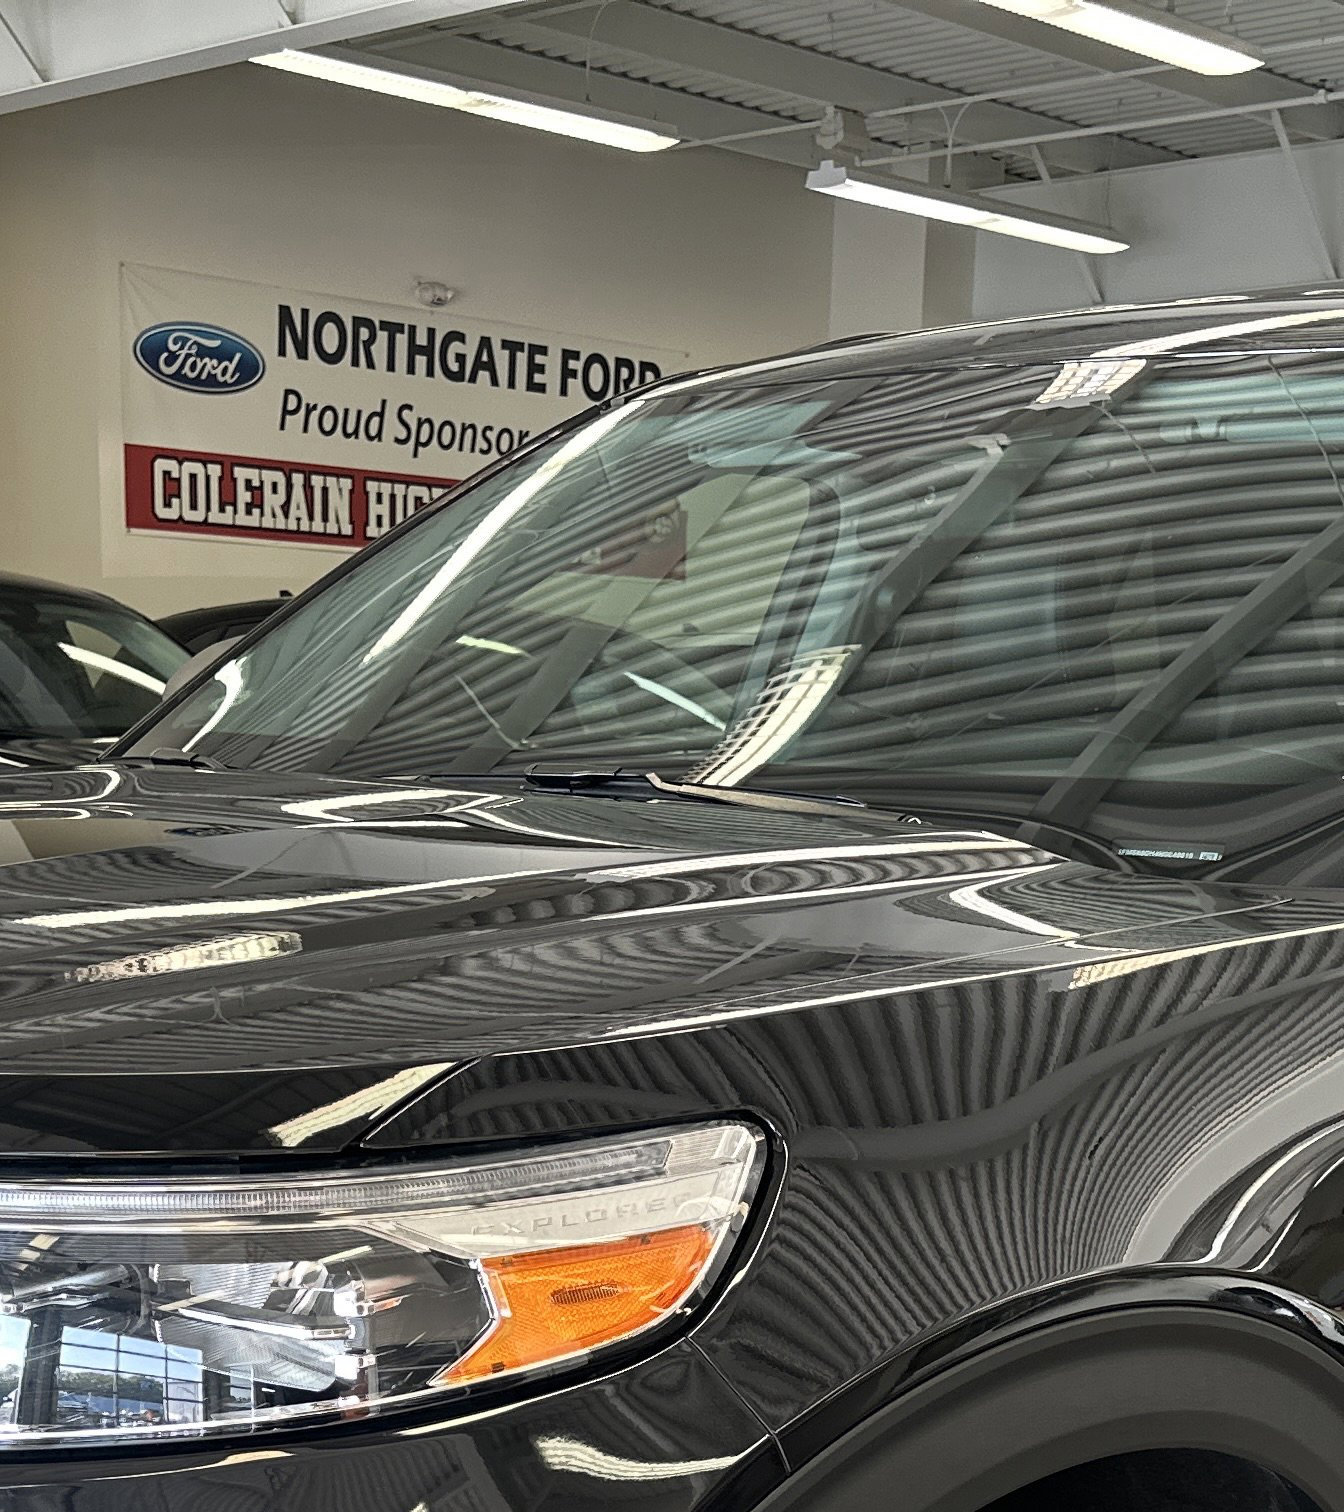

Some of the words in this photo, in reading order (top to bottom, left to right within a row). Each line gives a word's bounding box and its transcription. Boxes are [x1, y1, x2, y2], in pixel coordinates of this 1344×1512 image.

[277, 303, 548, 394] NORTHGATE
[279, 389, 385, 443] Proud
[394, 404, 530, 458] Sponsor
[153, 457, 353, 536] COLERAIN
[365, 480, 450, 538] HI
